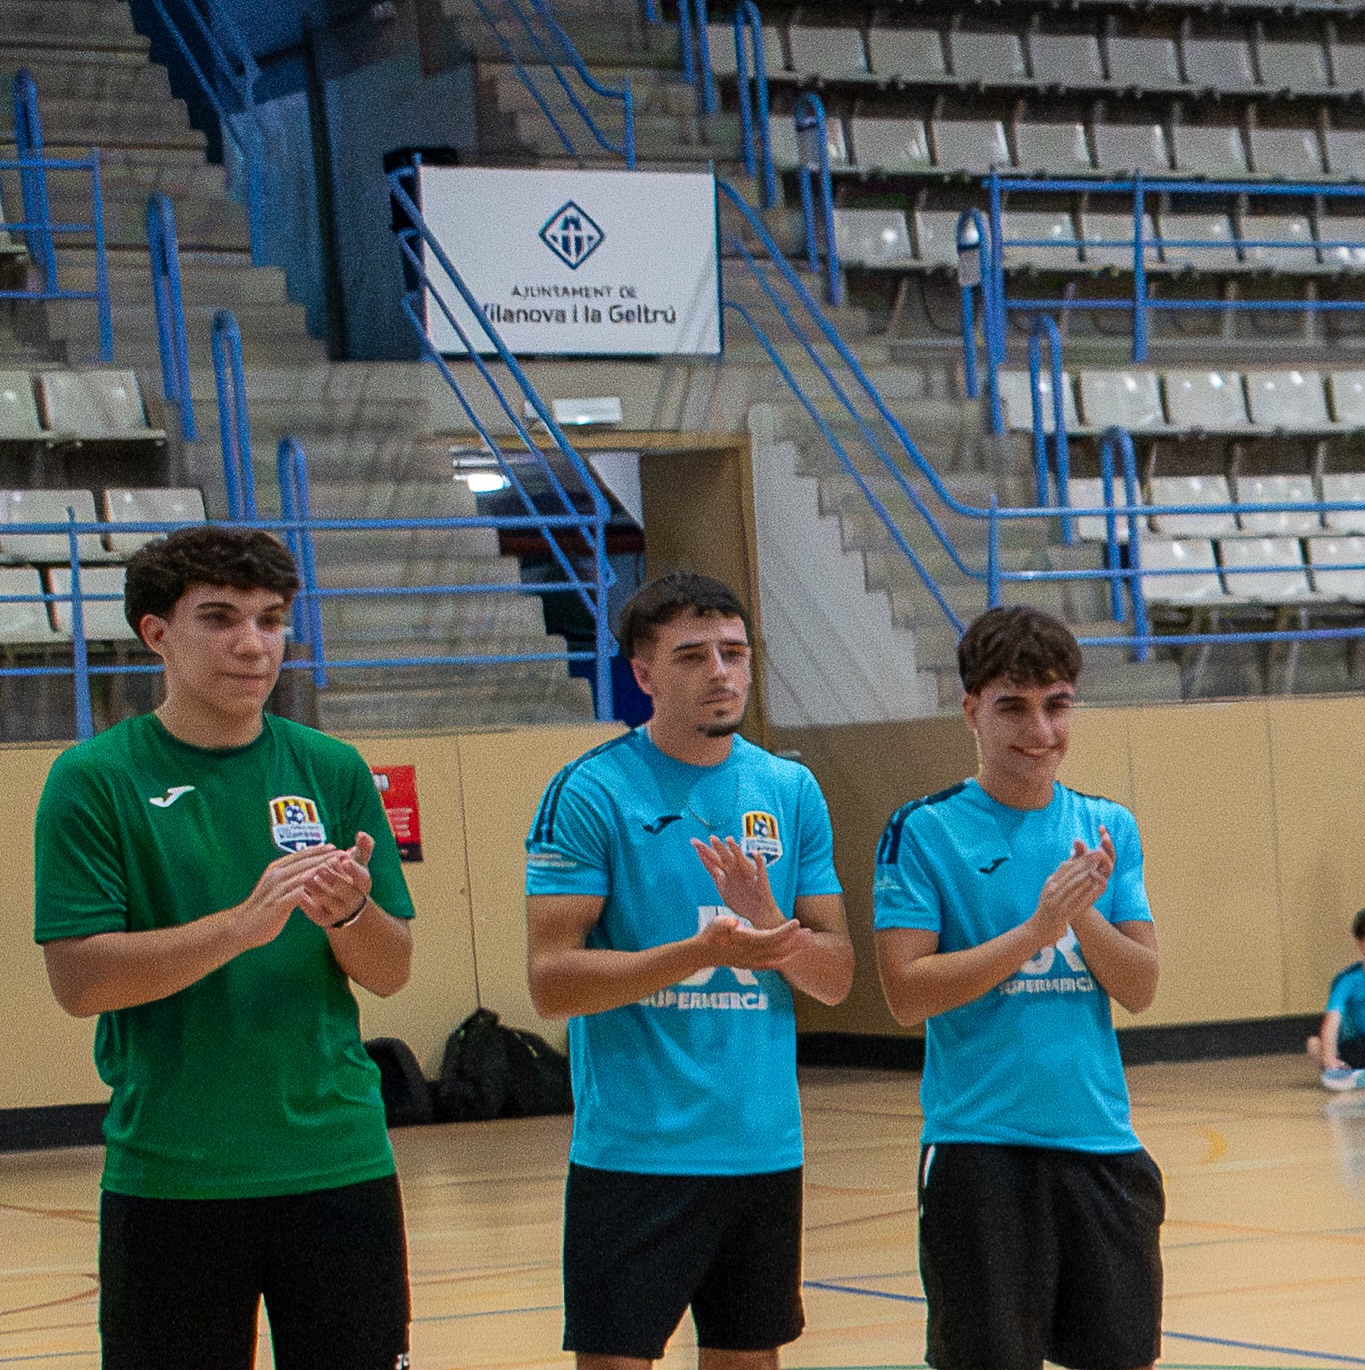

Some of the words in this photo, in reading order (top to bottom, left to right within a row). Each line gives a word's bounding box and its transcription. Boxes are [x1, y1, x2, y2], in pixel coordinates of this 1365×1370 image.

[511, 285, 612, 299] AJUNTAMENT
[585, 304, 602, 323] la
[609, 304, 677, 324] Geltrú
